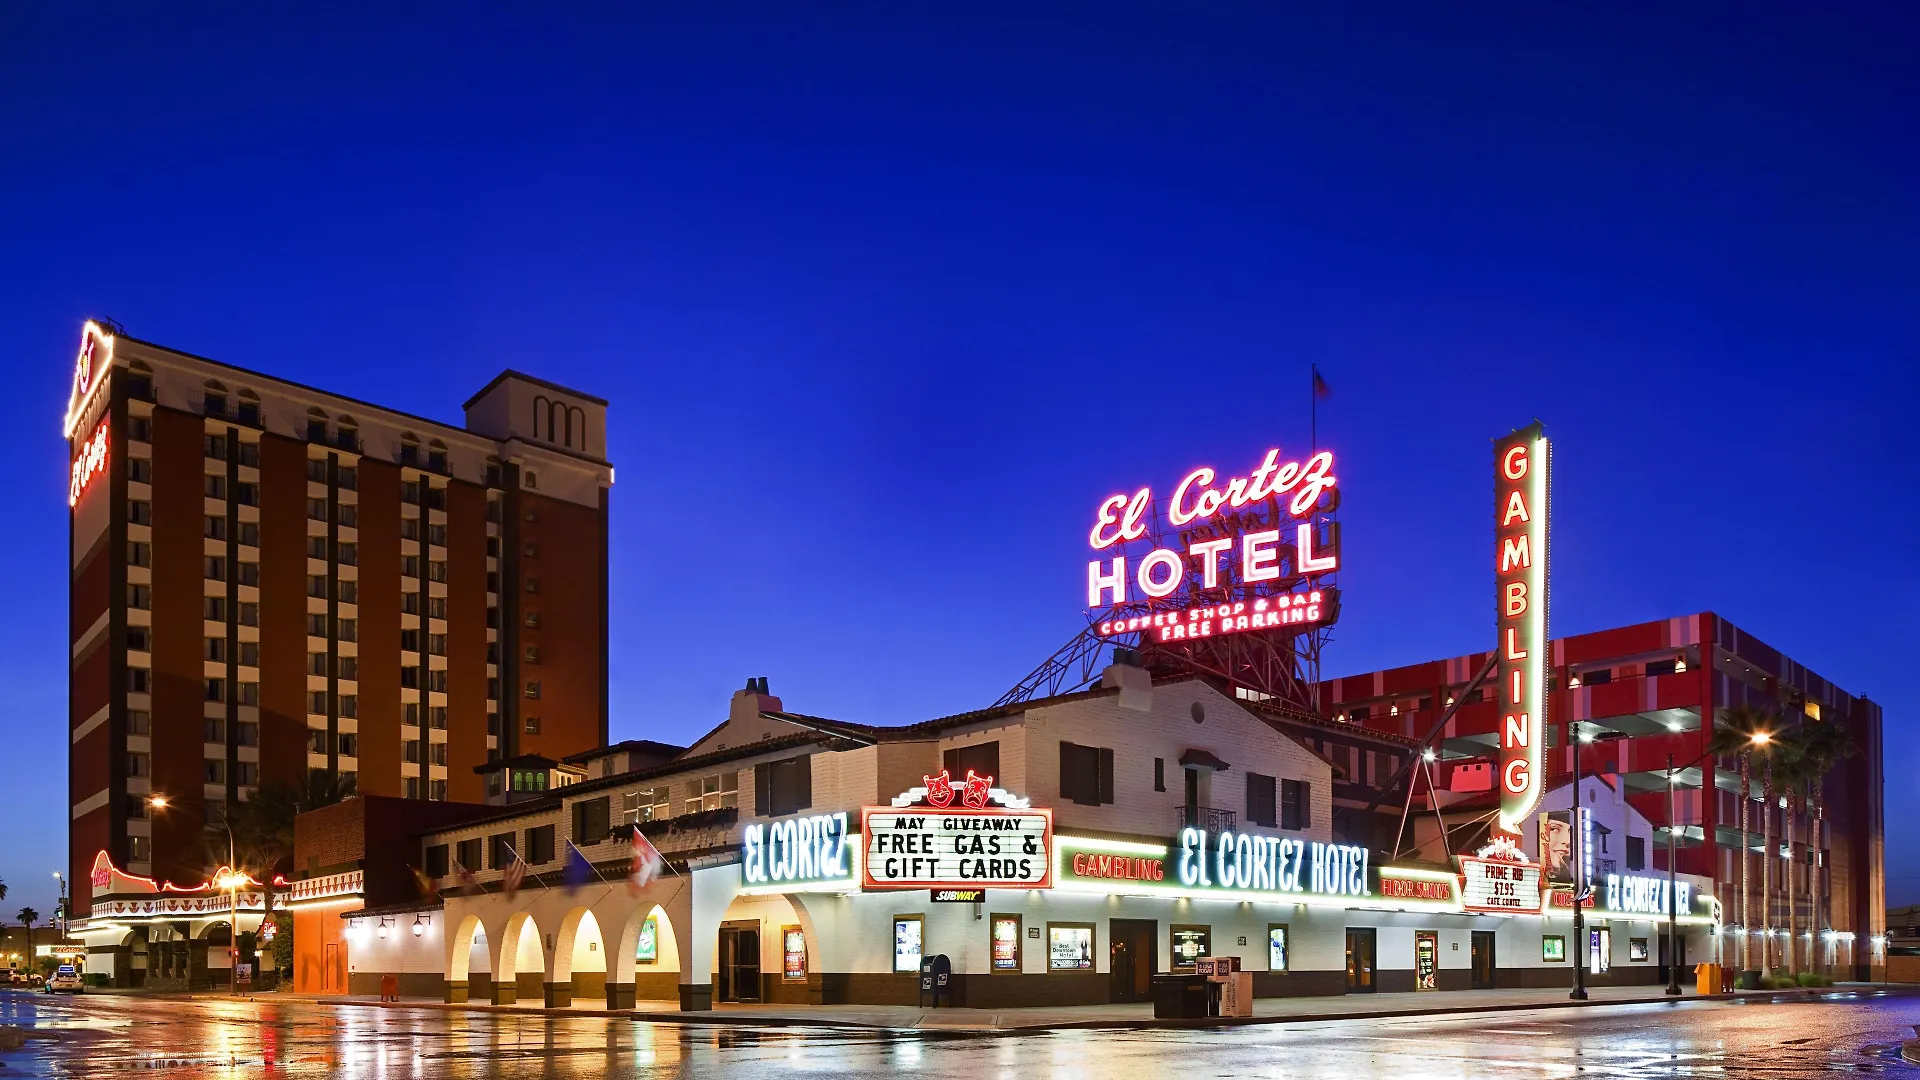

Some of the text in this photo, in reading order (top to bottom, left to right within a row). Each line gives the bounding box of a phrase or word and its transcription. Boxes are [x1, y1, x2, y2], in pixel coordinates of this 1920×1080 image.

[1089, 448, 1337, 550] El Cortez
[1088, 522, 1336, 608] HOTEL
[1100, 591, 1322, 635] COFFEE SHOP & BAR
[1162, 605, 1320, 641] FREE PARKING
[1502, 445, 1532, 794] GAMBLING
[895, 817, 1022, 831] MAY GIVEAWAY
[745, 812, 848, 882] EL CORTEZ
[878, 834, 1037, 855] FREE GAS &
[885, 858, 1031, 879] GIFT CARDS
[1073, 852, 1164, 881] GAMBLING
[1180, 827, 1372, 897] EL CORTEZ HOTEL
[1485, 865, 1523, 881] PRIME RIB
[936, 890, 977, 901] SUBWAY
[1382, 878, 1450, 900] FLOOR SHOWS
[1486, 897, 1521, 907] CAFE CORTEZ
[1553, 891, 1595, 908] COCAILS
[1607, 873, 1622, 911] EL
[1623, 875, 1660, 913] CORTEZ
[1662, 880, 1692, 915] HTEL
